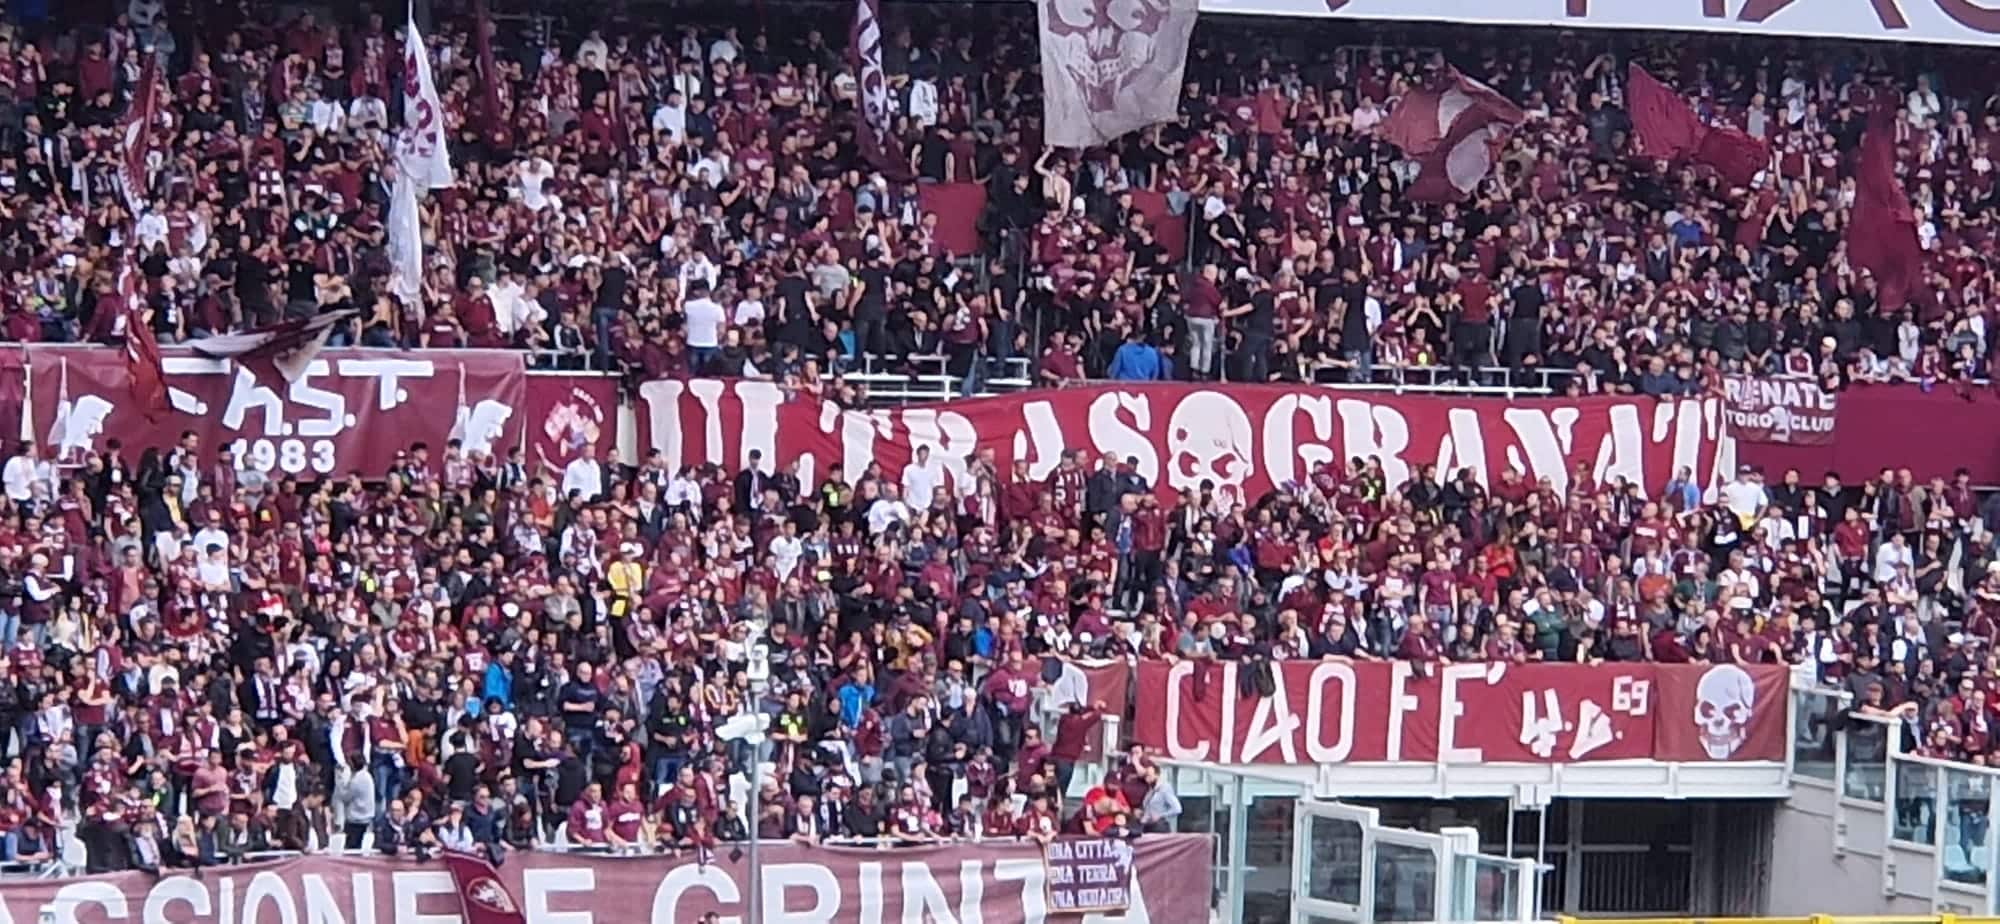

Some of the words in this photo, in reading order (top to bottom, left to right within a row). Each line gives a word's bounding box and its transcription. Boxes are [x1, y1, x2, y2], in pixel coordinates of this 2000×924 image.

[639, 379, 1160, 499] ULTRAS
[1726, 410, 1774, 429] TORO
[1791, 415, 1836, 432] CLUB
[230, 438, 335, 473] 1983
[1166, 661, 1357, 764] CIAO
[1612, 675, 1650, 715] 69
[523, 868, 595, 924] E
